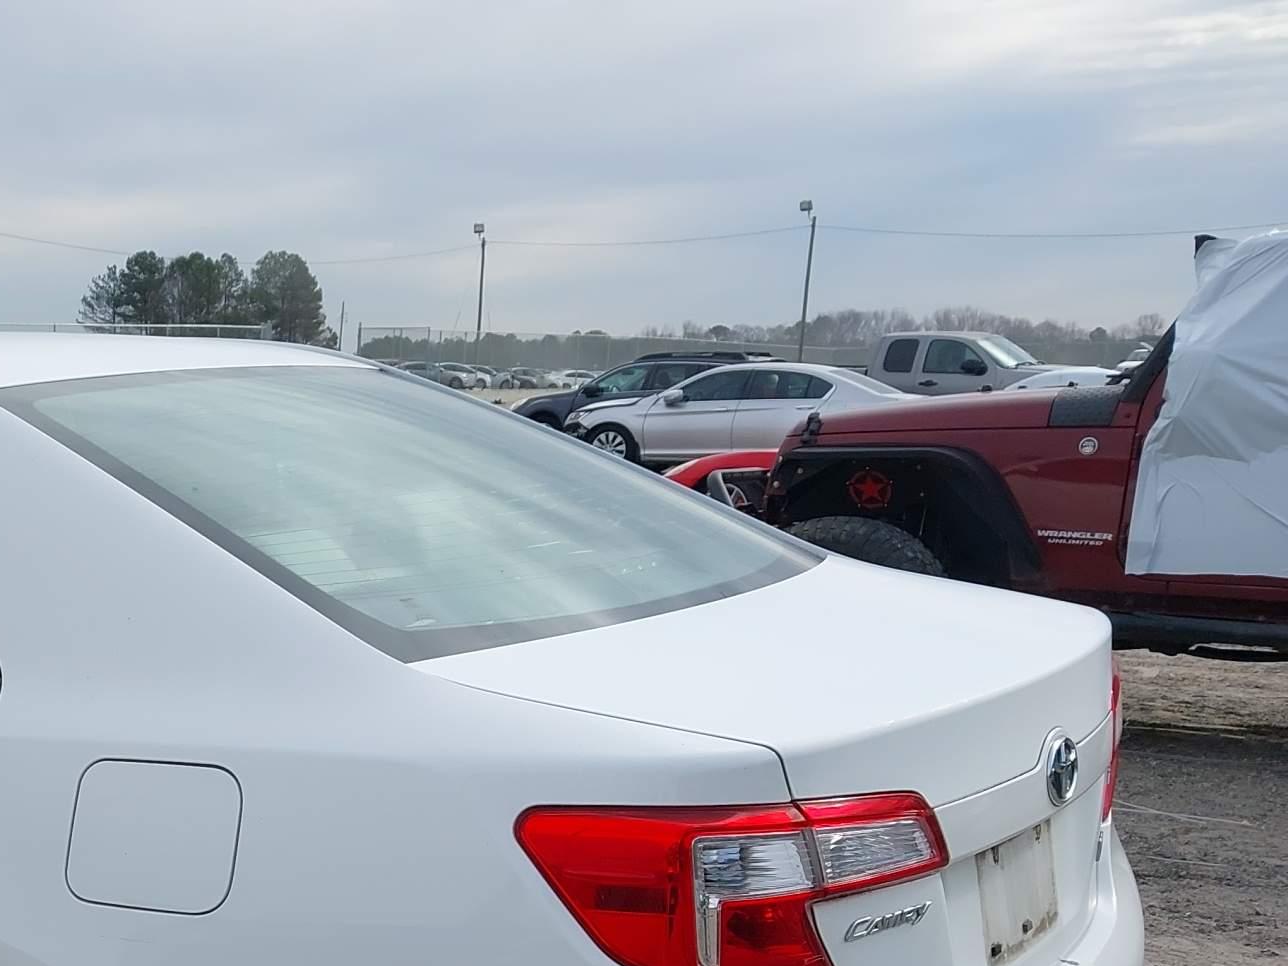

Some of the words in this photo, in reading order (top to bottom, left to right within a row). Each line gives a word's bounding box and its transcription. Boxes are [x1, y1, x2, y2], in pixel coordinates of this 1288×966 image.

[1037, 530, 1113, 541] WRANGLER
[1047, 538, 1104, 546] UNLIMITED
[844, 901, 932, 942] CAMRY
